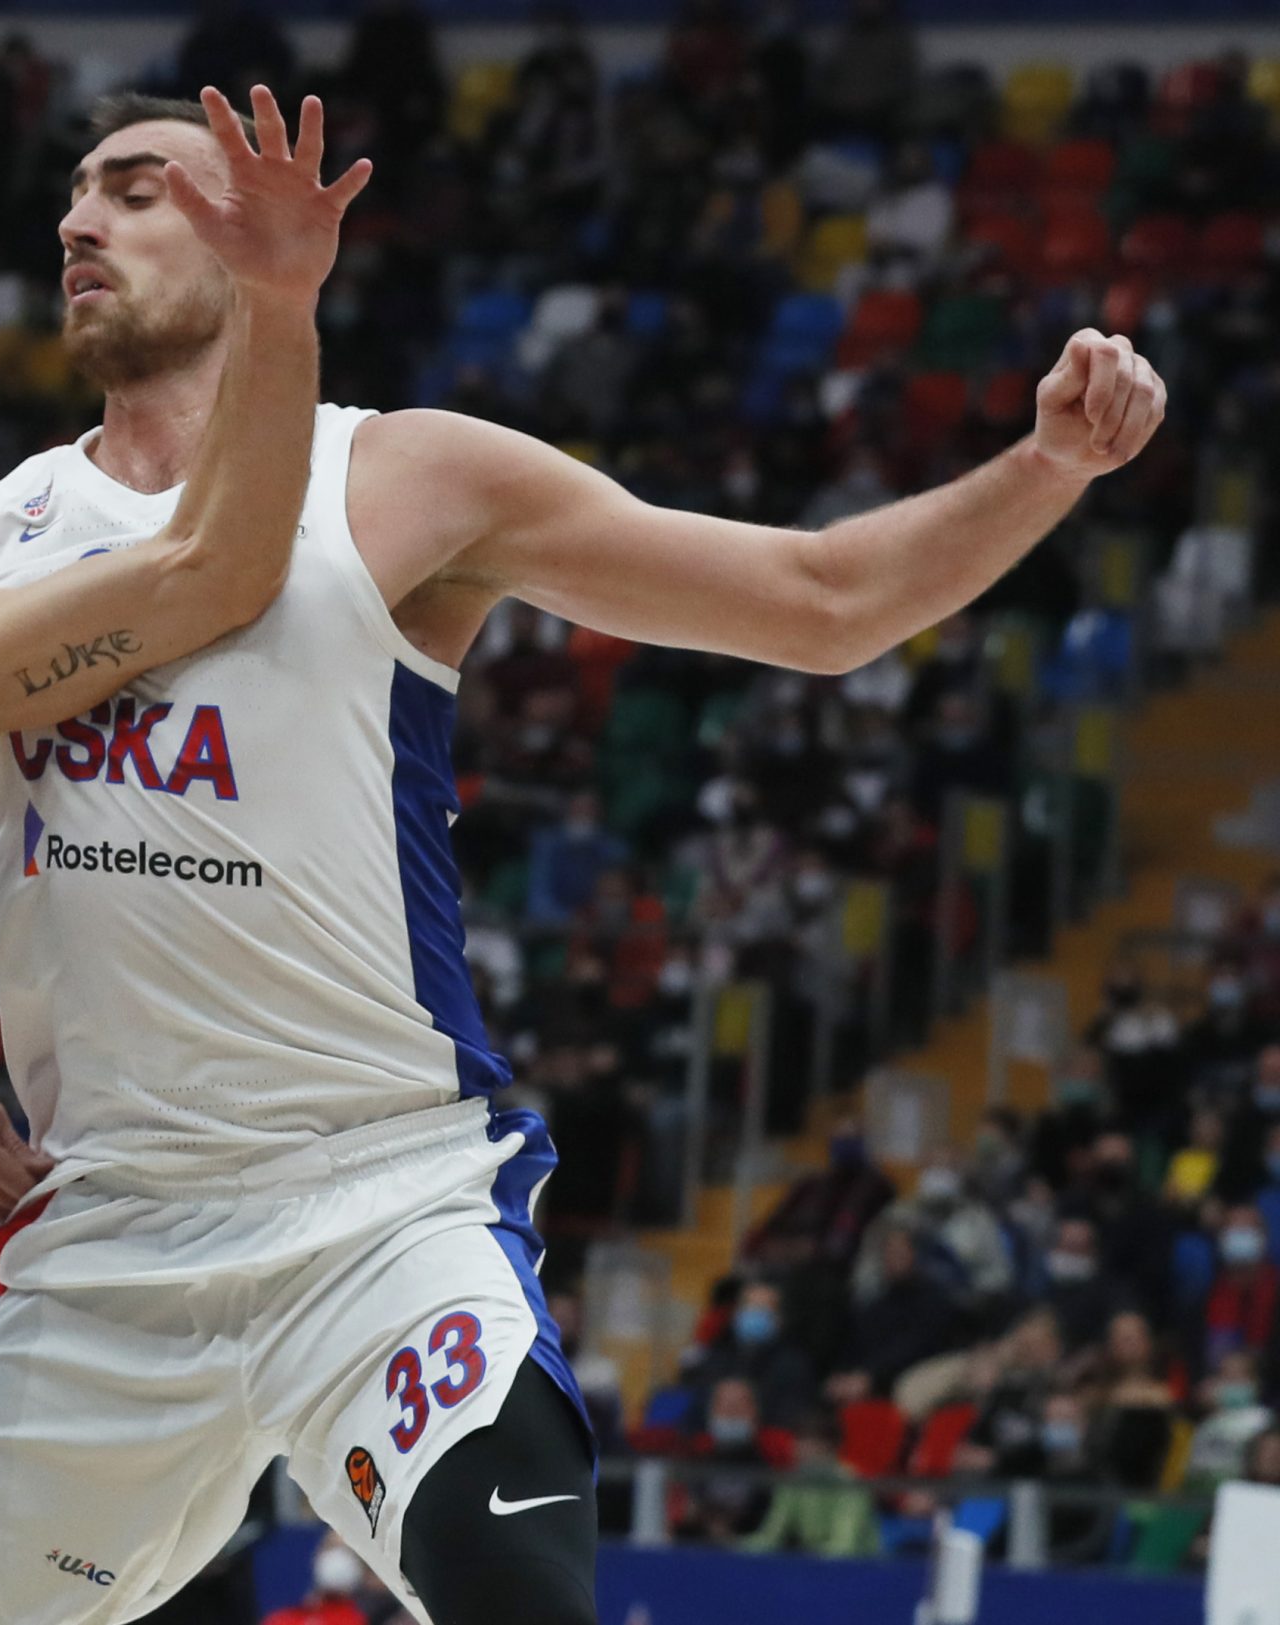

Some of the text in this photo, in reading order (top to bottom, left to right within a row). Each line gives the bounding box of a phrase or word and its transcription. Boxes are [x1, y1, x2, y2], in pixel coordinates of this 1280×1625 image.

[15, 630, 143, 697] LUKE
[46, 834, 262, 887] Rostelecom
[386, 1311, 487, 1454] 33
[58, 1554, 116, 1586] UAC
